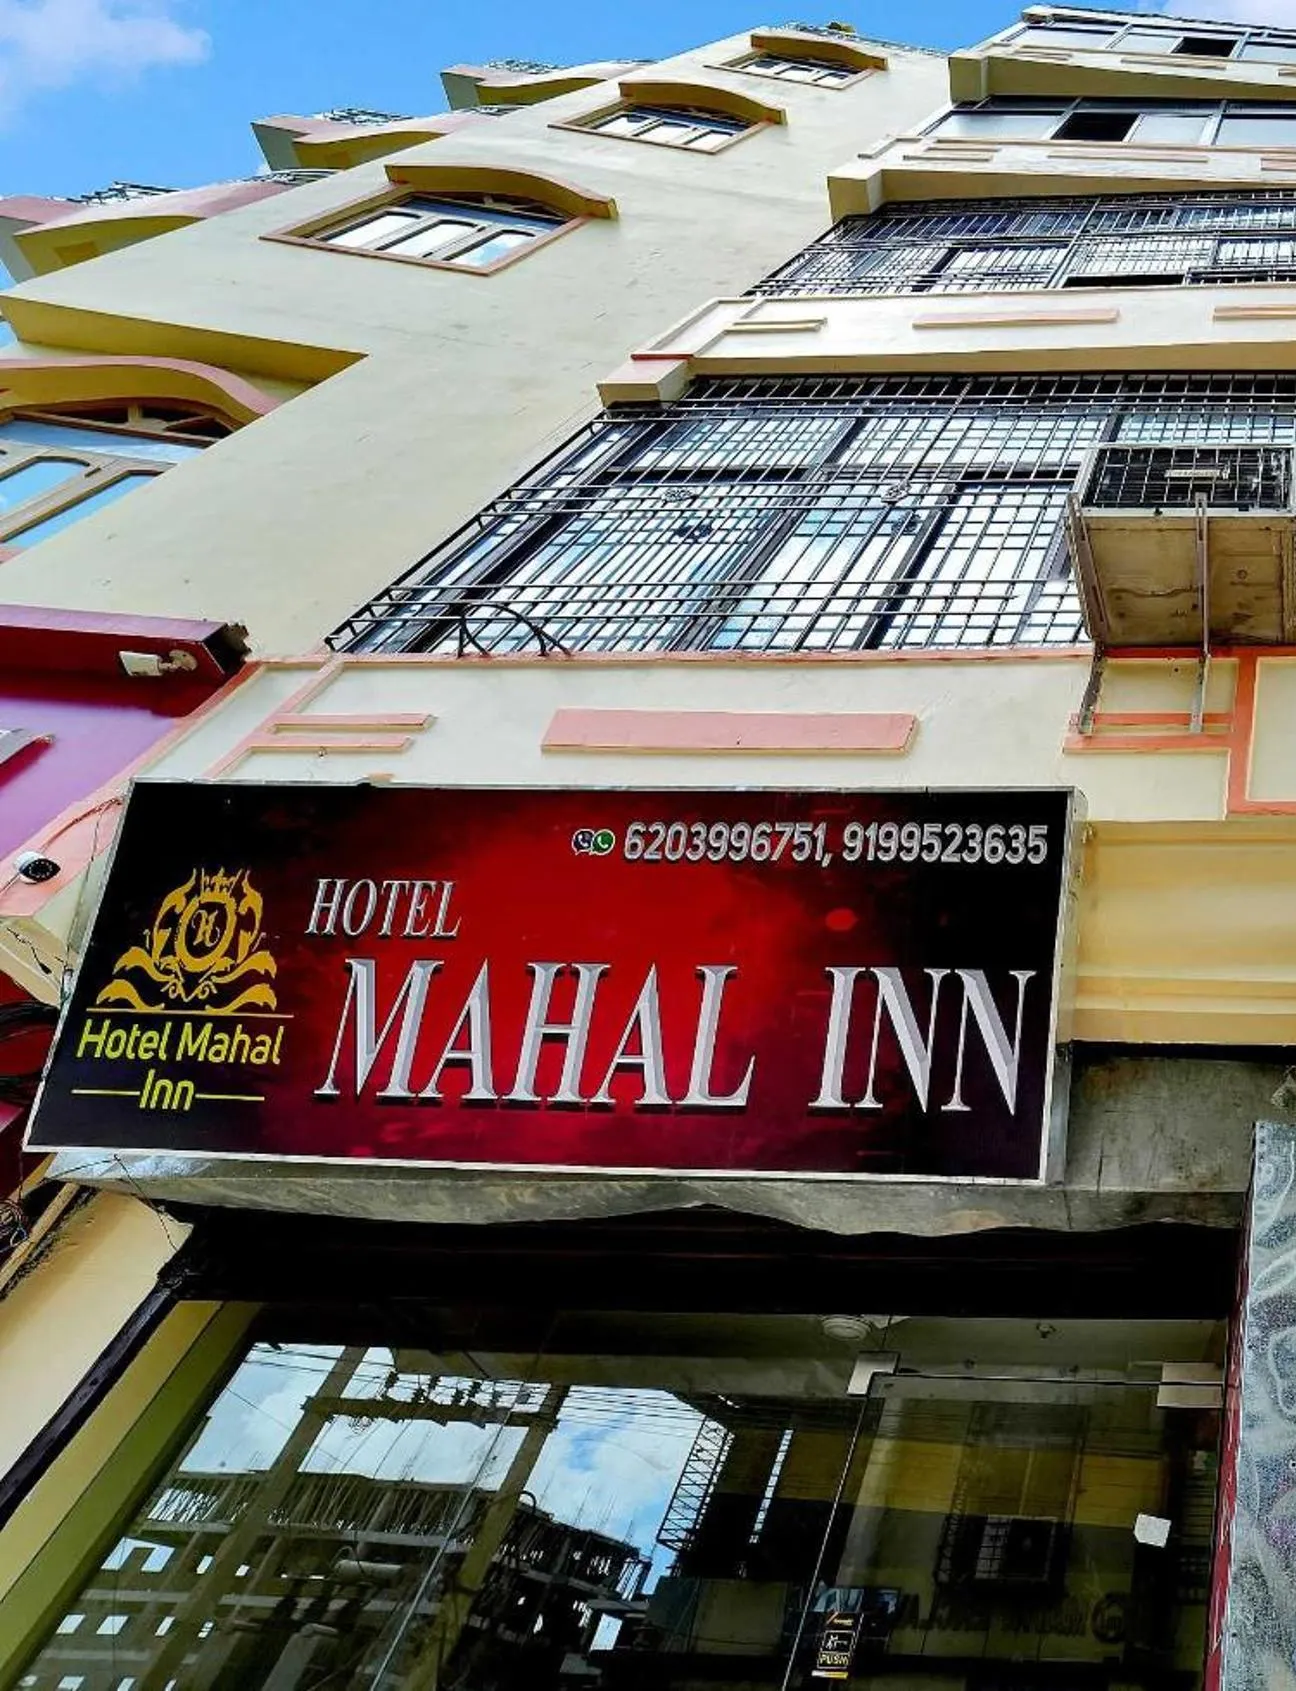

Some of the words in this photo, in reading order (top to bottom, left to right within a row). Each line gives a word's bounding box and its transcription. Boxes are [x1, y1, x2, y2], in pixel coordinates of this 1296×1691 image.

[623, 821, 831, 867] 6203996751,
[842, 822, 1048, 865] 9199523635
[304, 877, 462, 938] HOTEL
[76, 1018, 169, 1063] Hotel
[175, 1021, 283, 1066] Mahal
[312, 957, 756, 1107] MAHAL
[808, 965, 1038, 1117] INN
[138, 1069, 195, 1111] Inn
